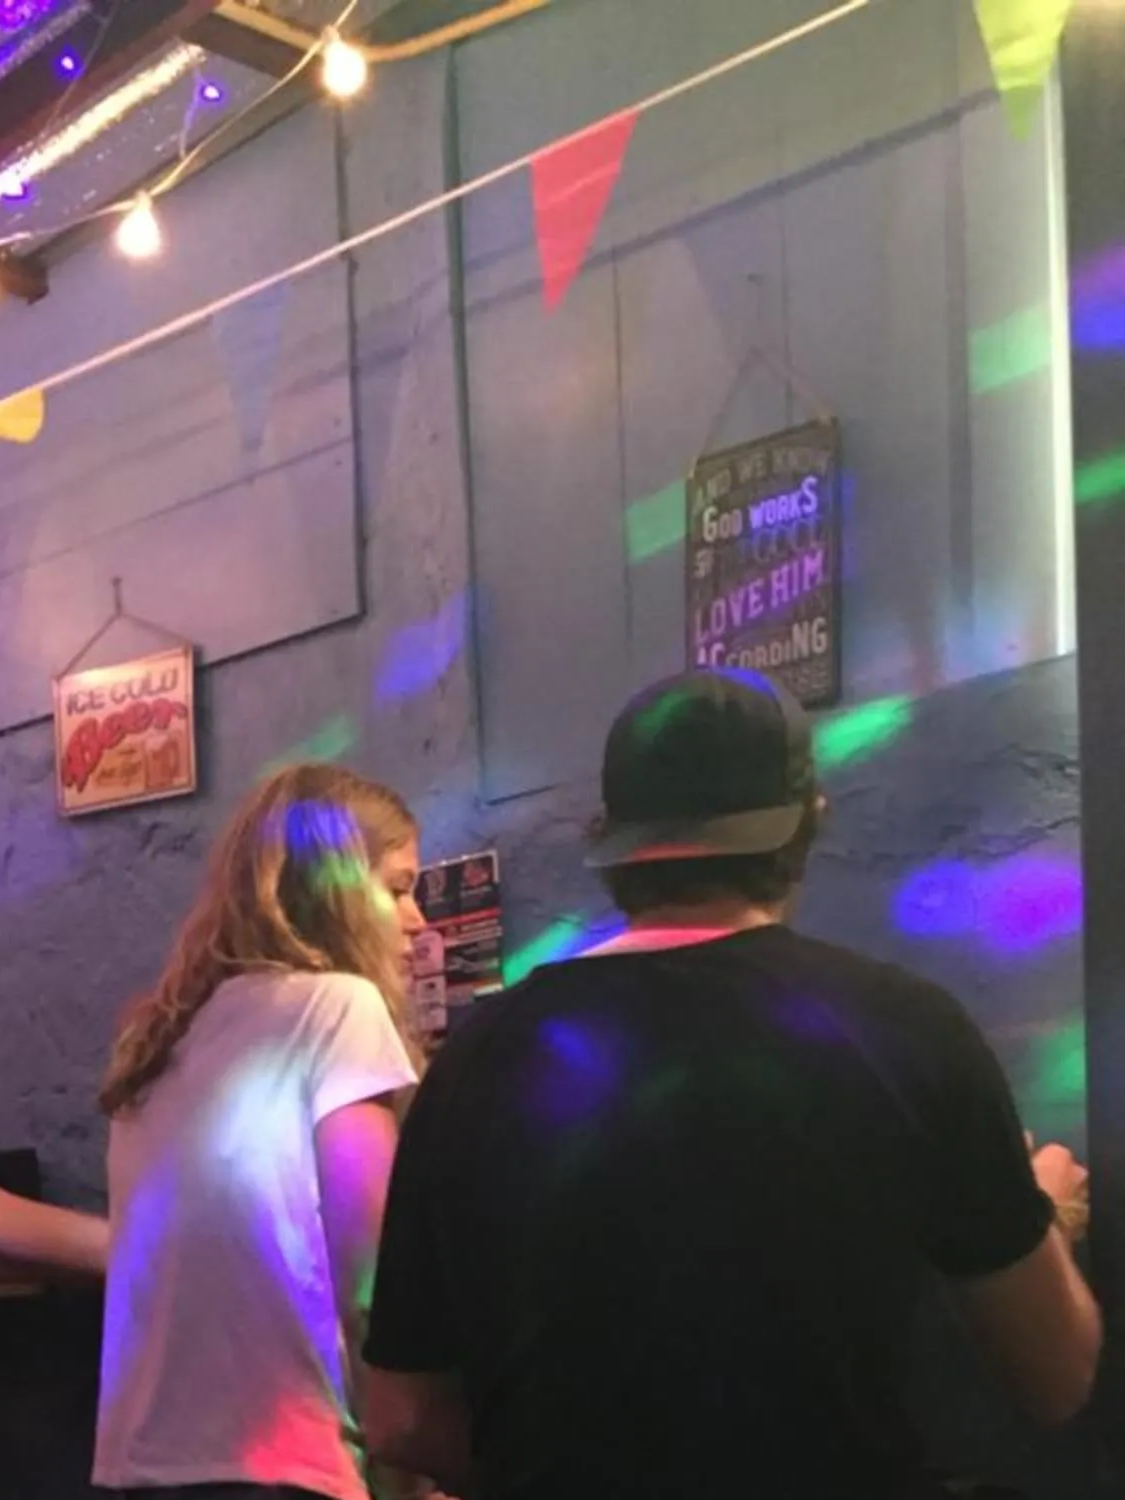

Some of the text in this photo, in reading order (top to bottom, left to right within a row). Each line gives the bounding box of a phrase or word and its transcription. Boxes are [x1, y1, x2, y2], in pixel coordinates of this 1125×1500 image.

[748, 475, 819, 530] WORKS
[694, 577, 765, 647] LOVE
[769, 549, 825, 609] HIM
[66, 668, 179, 717] ICE COLD
